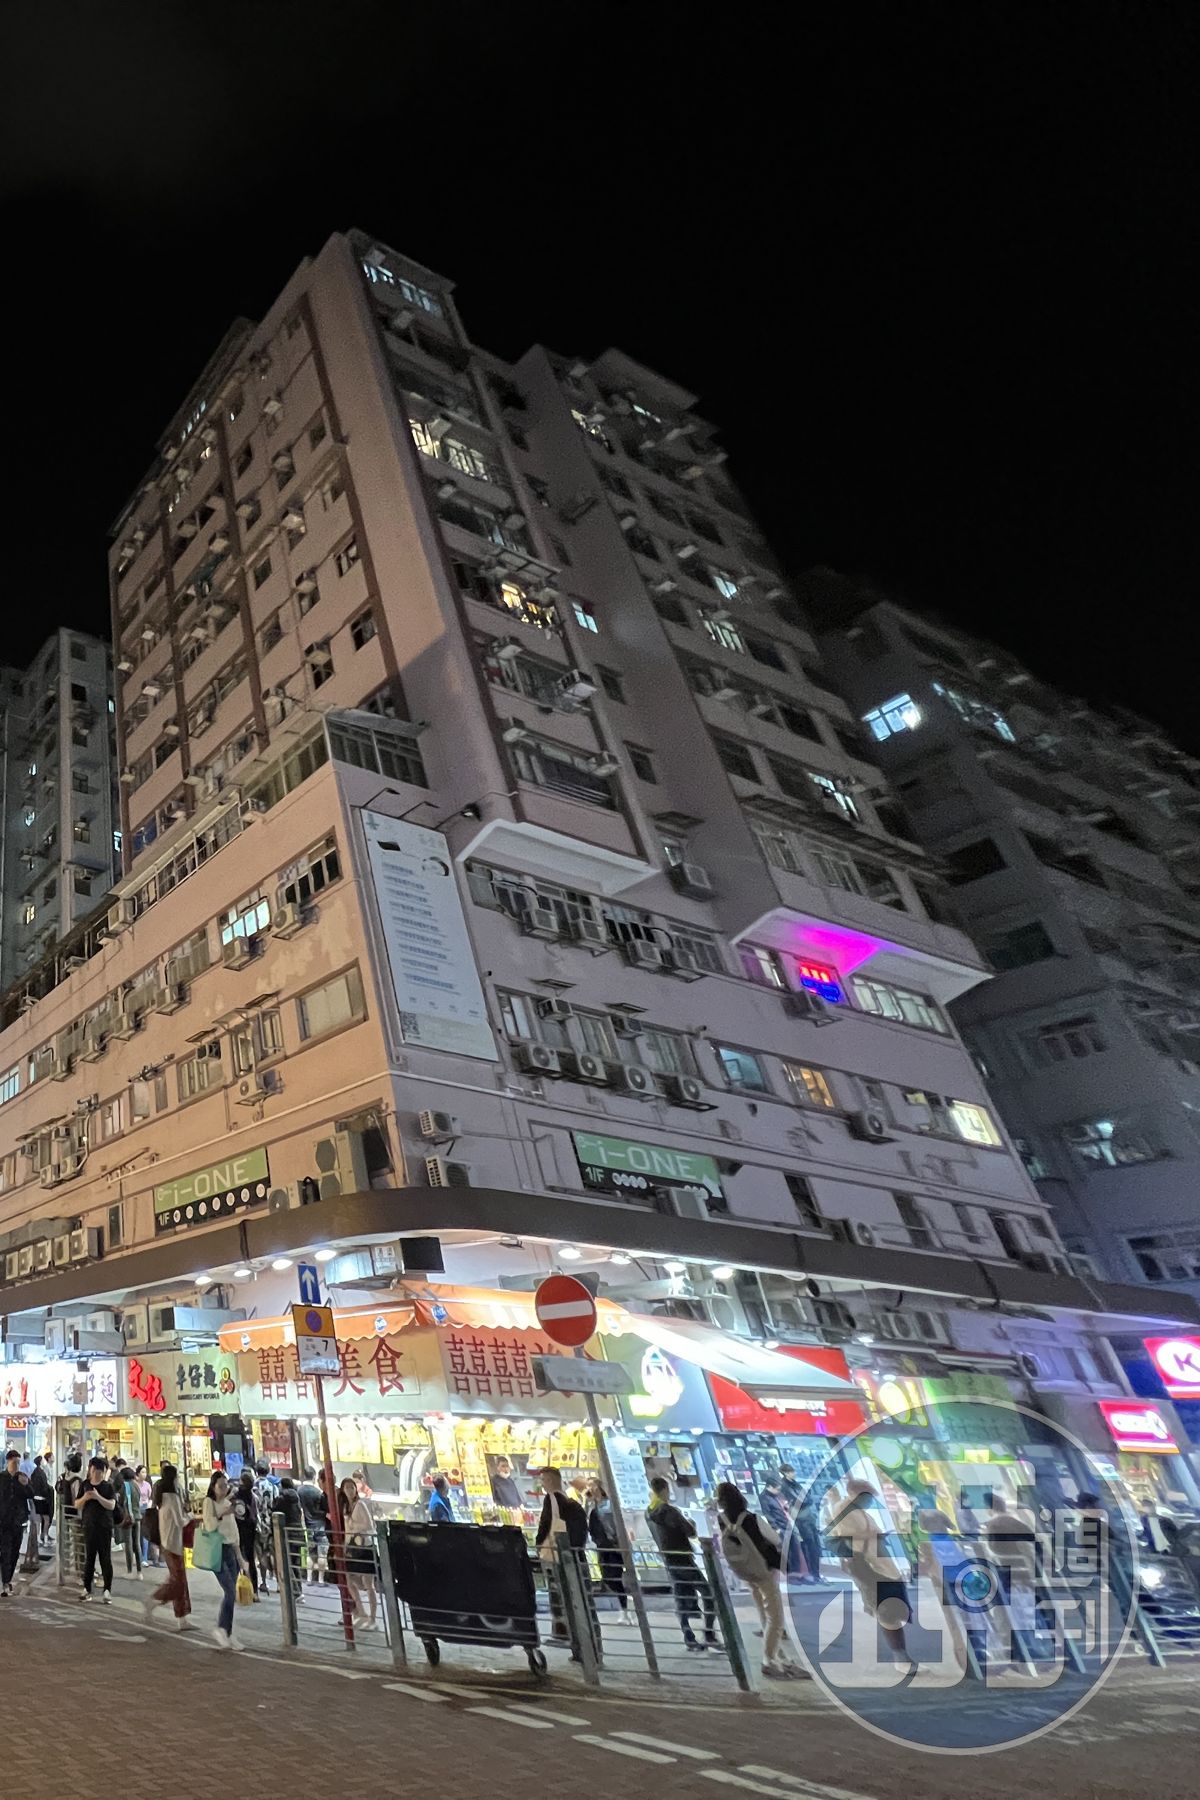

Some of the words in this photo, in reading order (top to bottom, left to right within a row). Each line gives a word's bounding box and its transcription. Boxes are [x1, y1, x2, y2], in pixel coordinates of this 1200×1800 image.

[597, 1140, 698, 1180] i-ONE
[173, 1157, 249, 1205] i-ONE
[585, 1166, 605, 1183] 1/F
[158, 1212, 170, 1226] 1/F
[322, 1339, 329, 1352] 7
[1173, 1352, 1200, 1373] K
